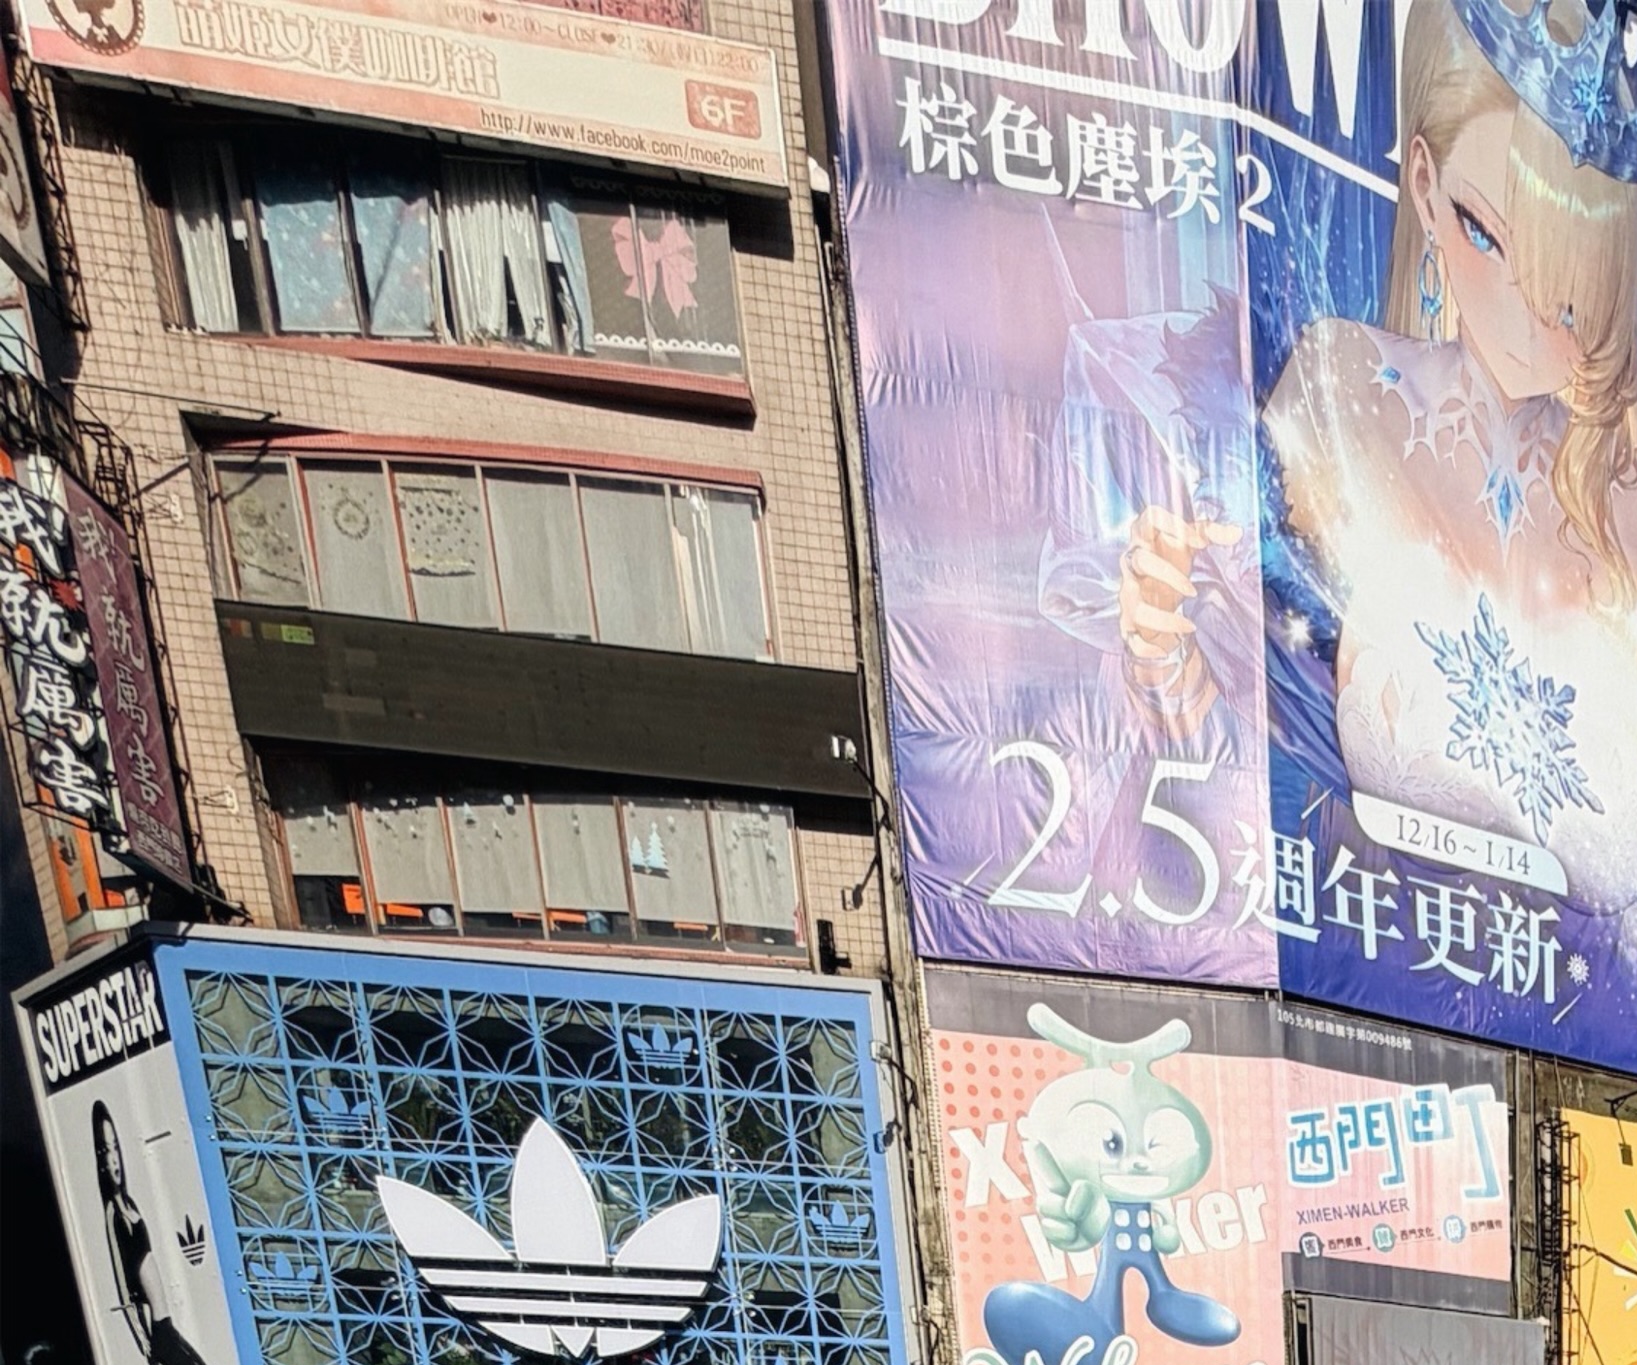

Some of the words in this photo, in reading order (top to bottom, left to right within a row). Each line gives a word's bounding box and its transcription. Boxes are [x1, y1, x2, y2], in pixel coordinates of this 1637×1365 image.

[480, 107, 766, 175] http://www.facebook.com/moe2point
[700, 94, 747, 129] 6F
[896, 76, 1276, 238] 棕色塵埃2
[987, 740, 1564, 1005] 2.5週年更新
[1396, 813, 1458, 857] 12/16
[1485, 853, 1532, 878] 1/14
[36, 966, 164, 1083] SUPERSTAR
[1288, 1088, 1501, 1199] 西門町
[1020, 1184, 1268, 1283] Wker
[1297, 1198, 1411, 1226] XIMEN-WALKER
